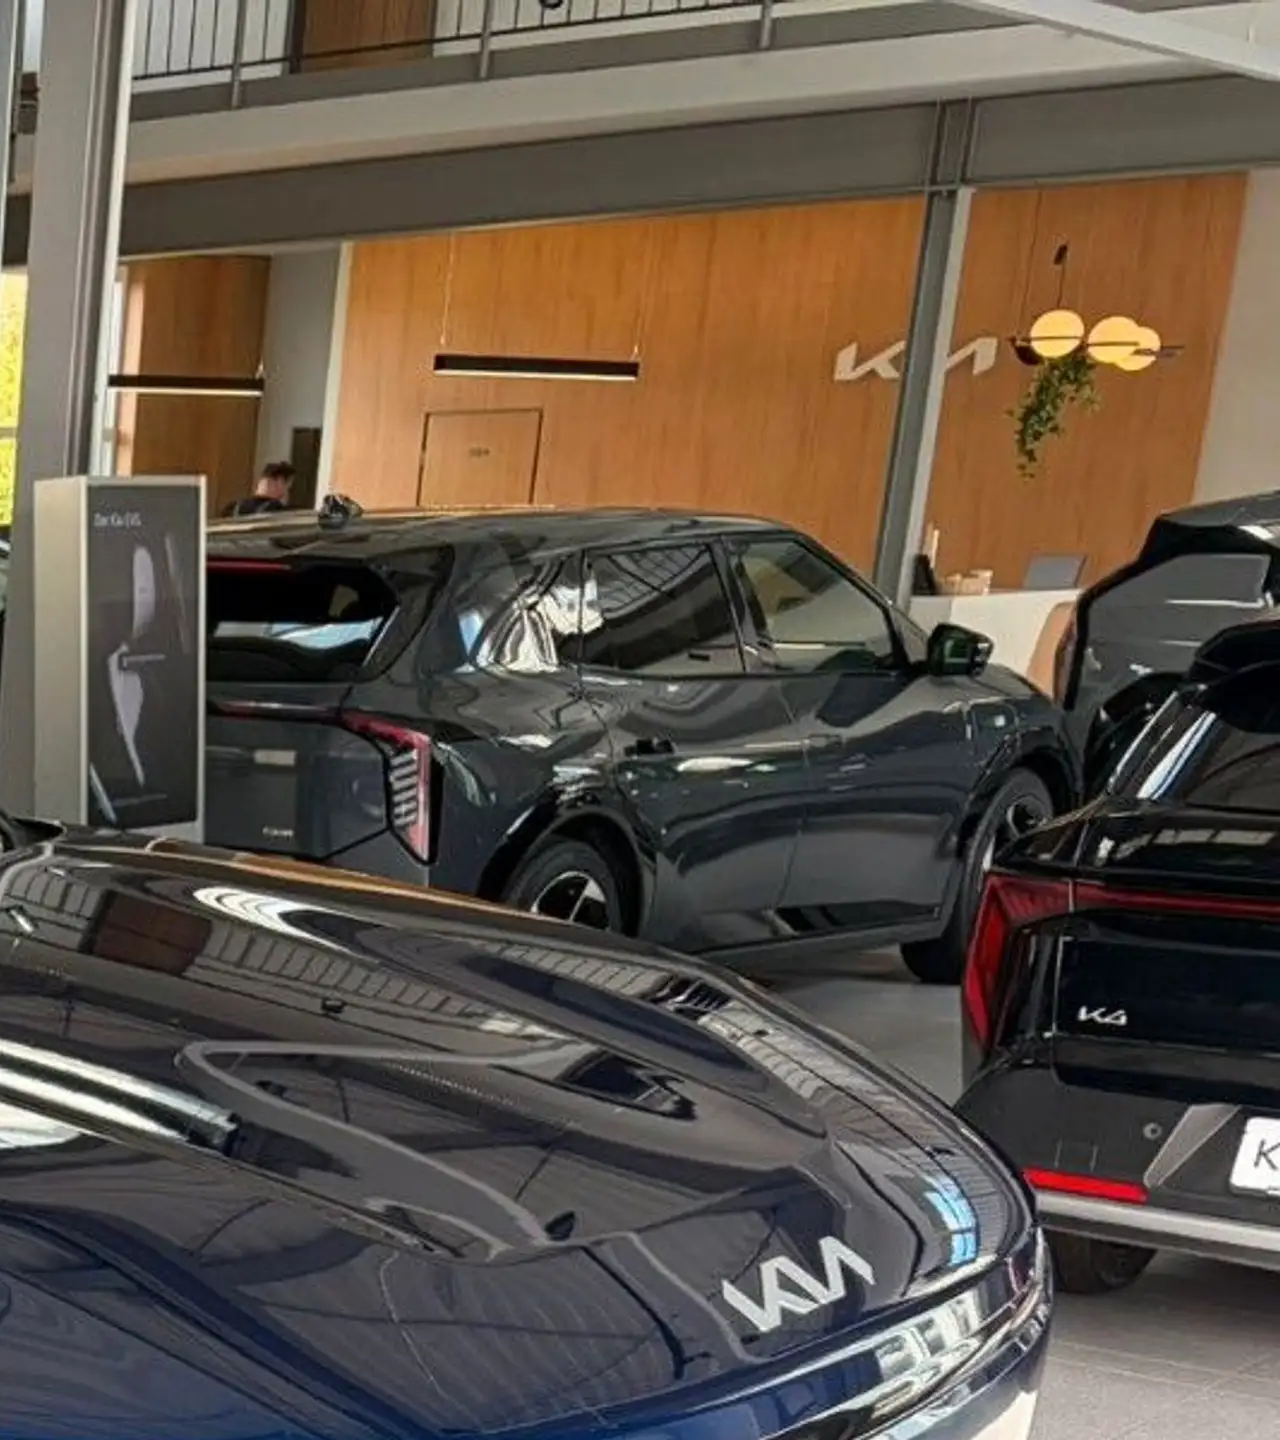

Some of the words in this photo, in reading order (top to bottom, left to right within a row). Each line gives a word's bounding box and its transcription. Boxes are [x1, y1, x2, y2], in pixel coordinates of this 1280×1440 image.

[834, 337, 998, 382] KA
[1078, 1005, 1128, 1026] K4
[721, 1236, 876, 1332] KIA
